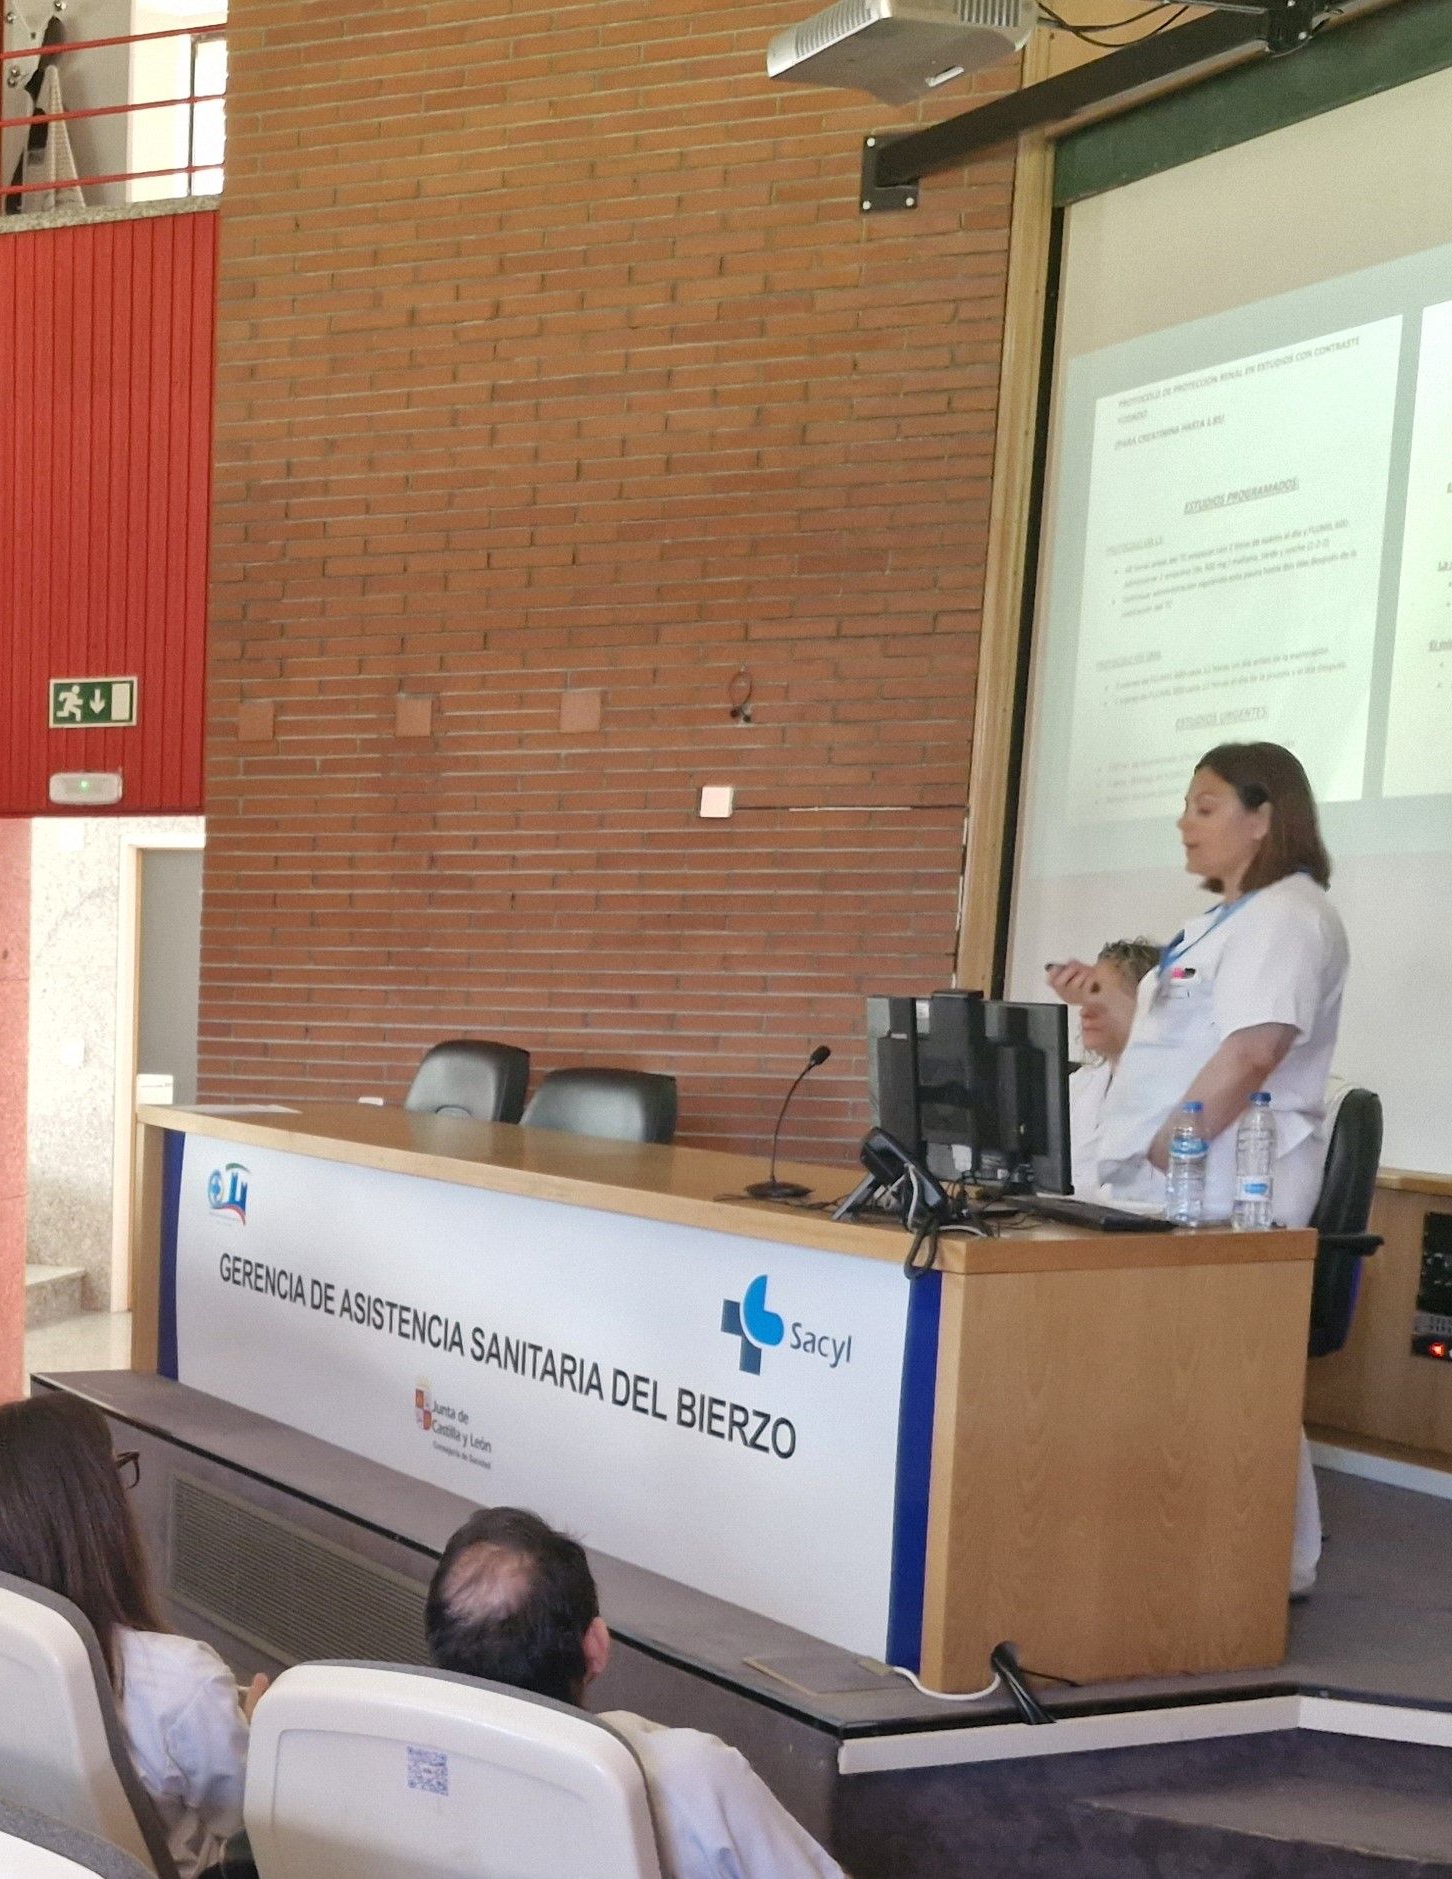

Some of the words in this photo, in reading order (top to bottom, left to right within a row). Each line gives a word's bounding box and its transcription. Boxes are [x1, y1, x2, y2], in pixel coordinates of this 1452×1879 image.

[1314, 336, 1360, 356] CONTRASTE
[220, 1253, 306, 1306] GERENCIA
[311, 1279, 335, 1316] DE
[339, 1288, 465, 1356] ASISTENCIA
[470, 1326, 604, 1401] SANITARIA
[611, 1367, 667, 1421] DEL
[676, 1387, 797, 1460] BIERZO
[790, 1322, 852, 1368] Sacyl
[432, 1400, 456, 1420] Junta
[458, 1410, 470, 1424] de
[432, 1419, 461, 1441] Castilla
[462, 1433, 469, 1448] y
[470, 1433, 492, 1453] León
